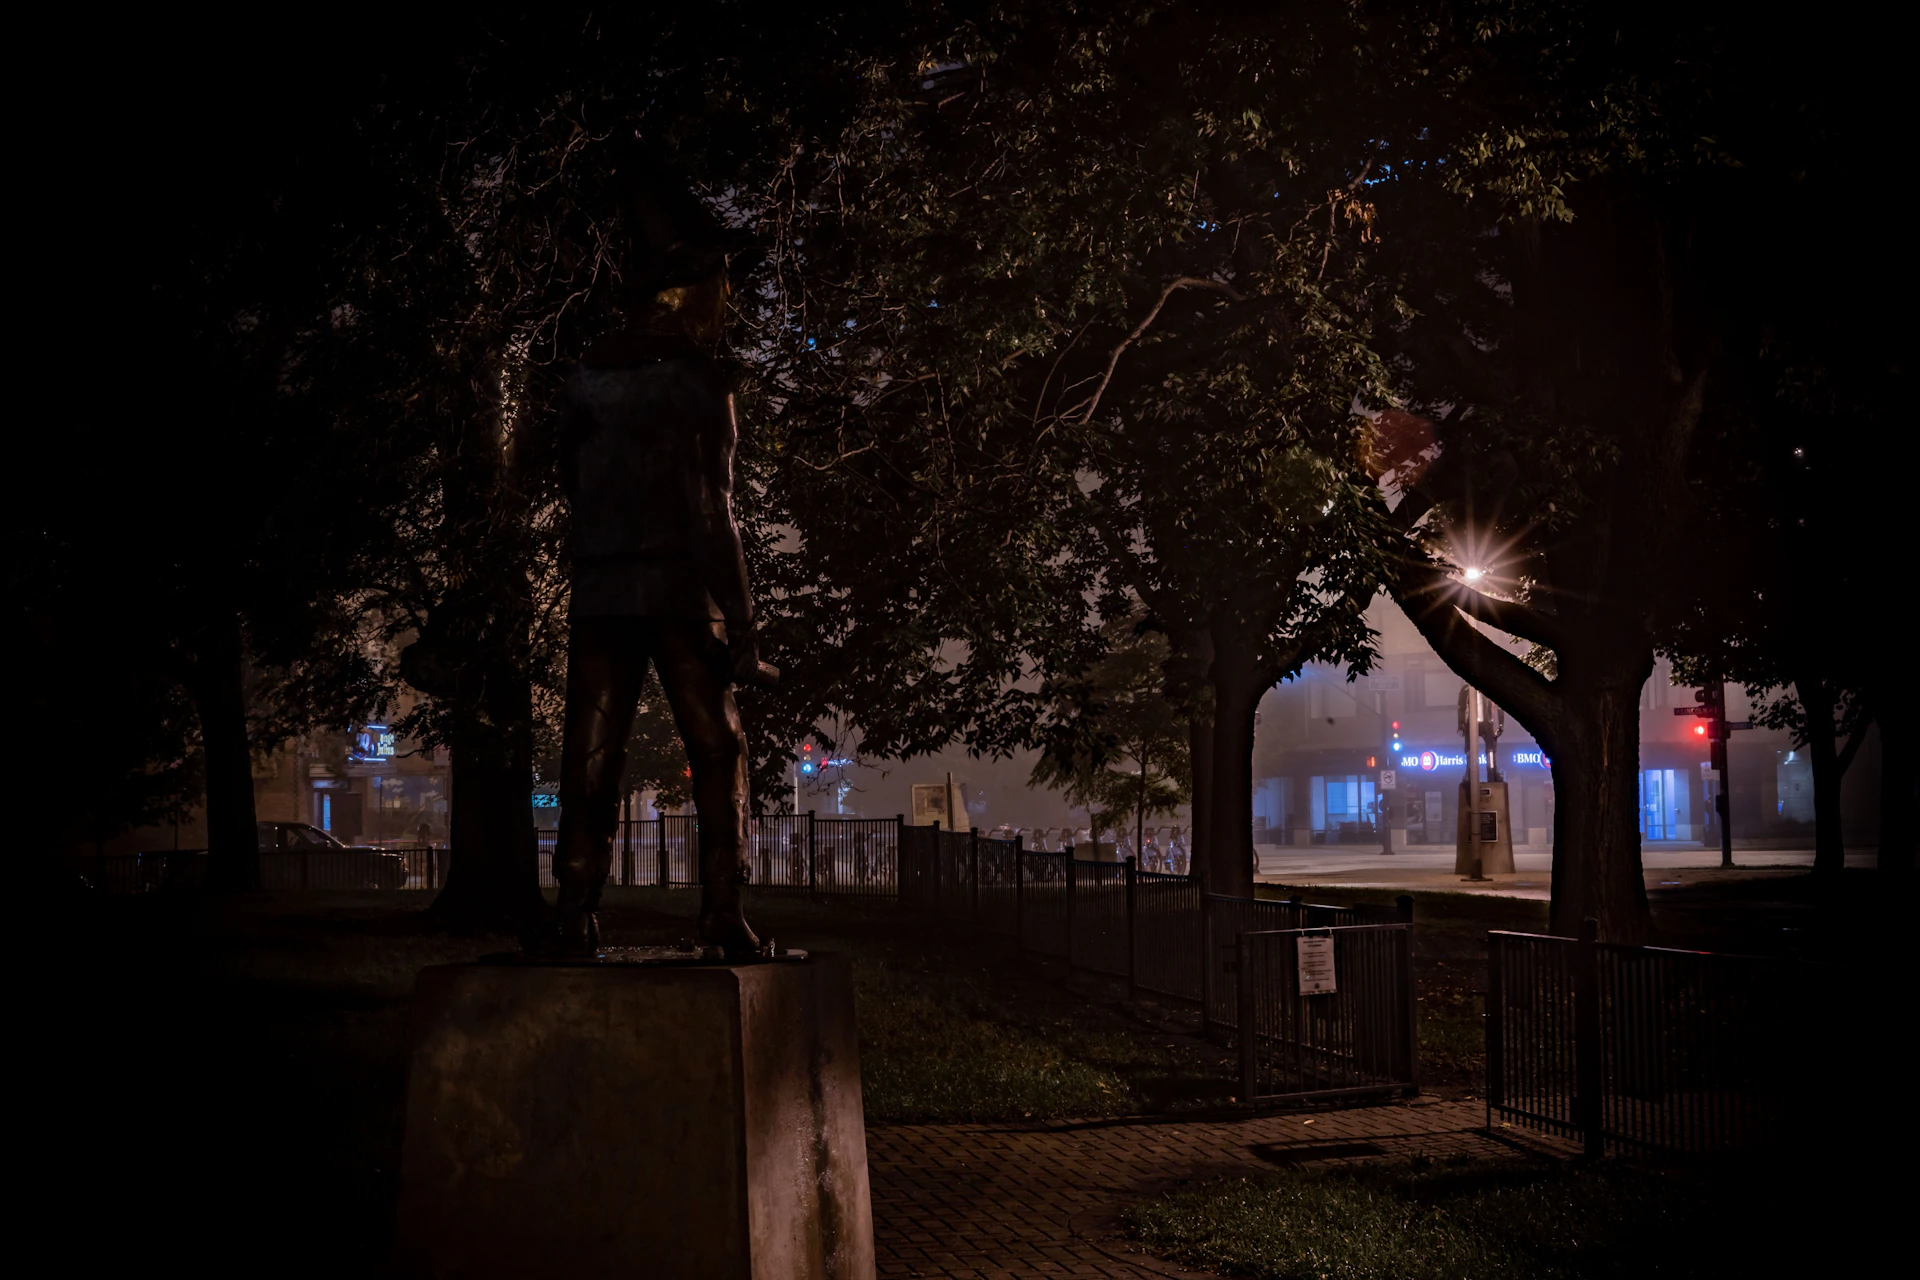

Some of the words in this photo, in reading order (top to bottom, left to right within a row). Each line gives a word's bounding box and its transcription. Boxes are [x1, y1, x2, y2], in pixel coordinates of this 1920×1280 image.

[377, 742, 394, 756] Julius
[1401, 756, 1418, 767] MO
[1436, 755, 1464, 766] Harris
[1517, 753, 1540, 764] BMO
